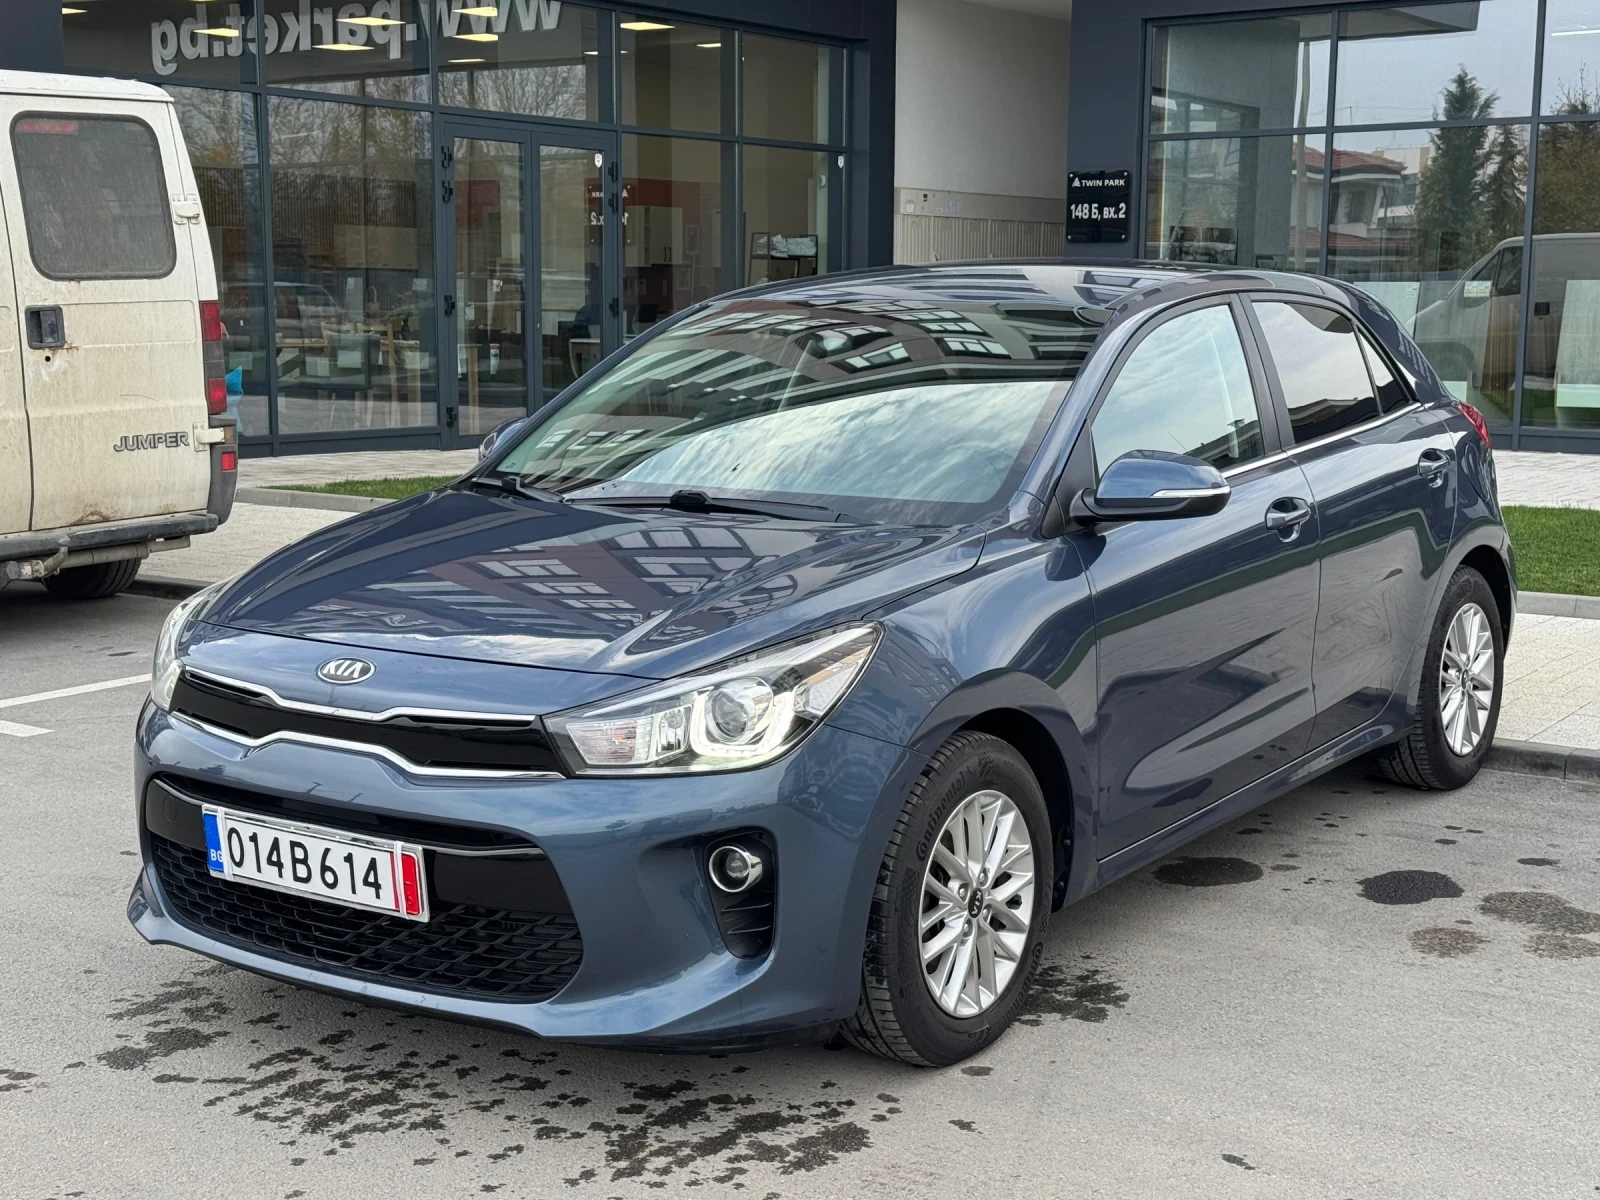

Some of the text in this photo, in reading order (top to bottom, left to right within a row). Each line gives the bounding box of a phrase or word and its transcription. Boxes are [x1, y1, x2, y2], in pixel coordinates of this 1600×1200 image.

[1104, 179, 1126, 187] PARK
[1070, 203, 1090, 219] 148
[113, 431, 190, 452] JUMPER
[323, 659, 364, 679] KIA
[210, 848, 223, 863] BG
[227, 826, 382, 900] 014B614
[971, 890, 982, 915] KIA
